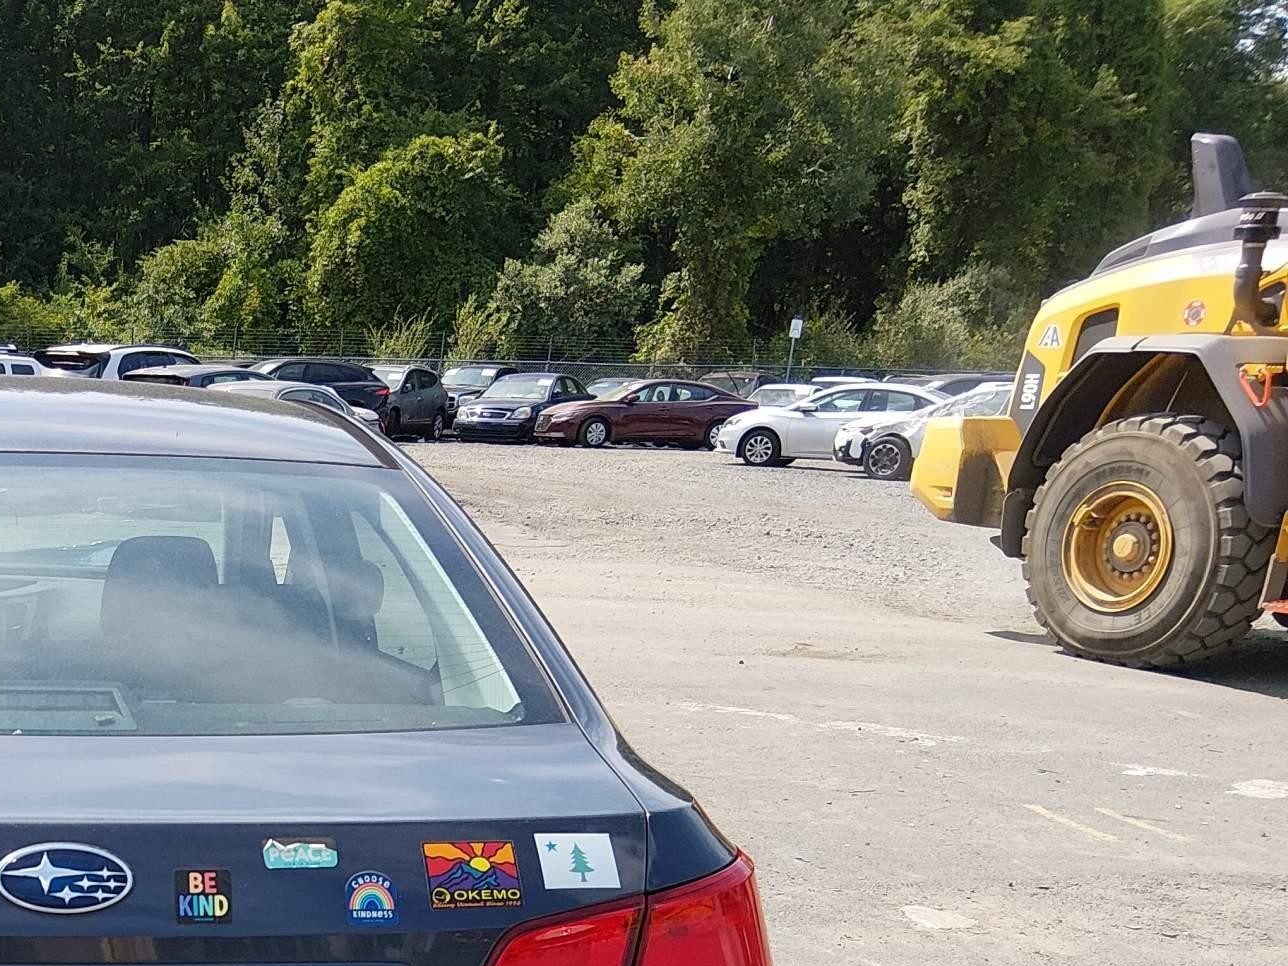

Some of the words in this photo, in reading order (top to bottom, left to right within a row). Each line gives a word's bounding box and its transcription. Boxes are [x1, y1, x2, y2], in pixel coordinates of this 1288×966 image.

[189, 872, 217, 894] BE
[454, 889, 521, 900] OKEMO
[178, 895, 229, 917] KIND
